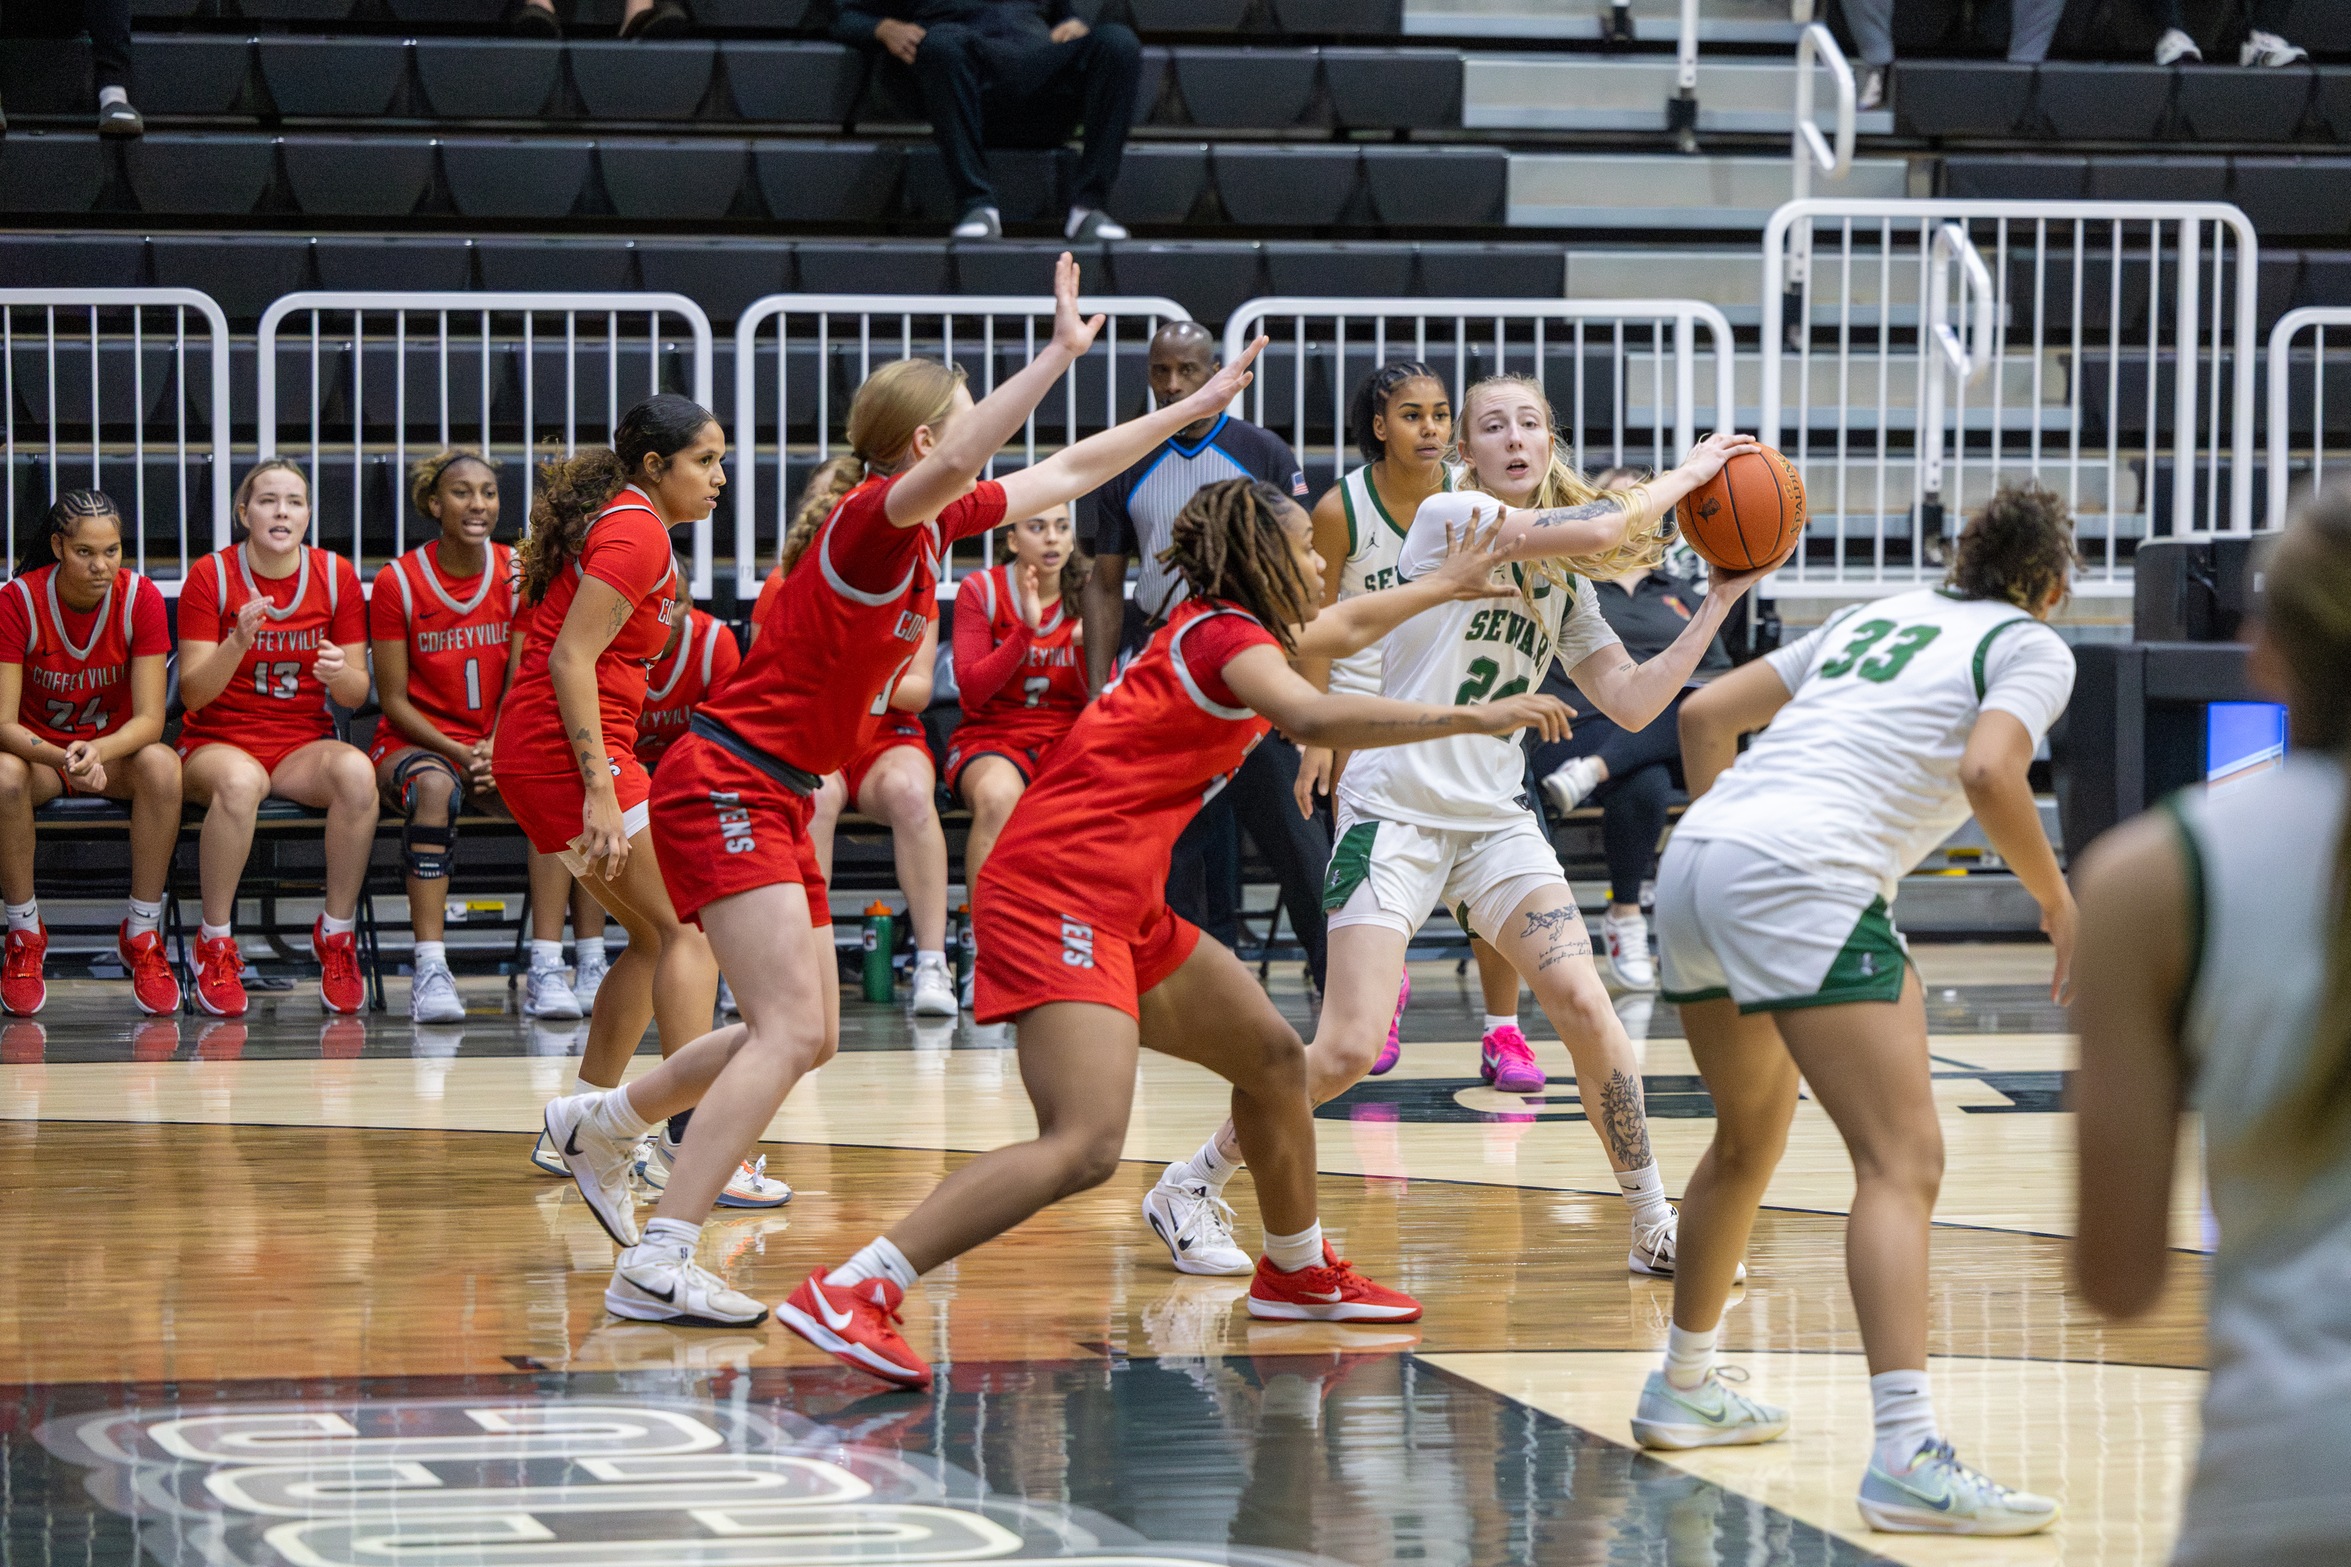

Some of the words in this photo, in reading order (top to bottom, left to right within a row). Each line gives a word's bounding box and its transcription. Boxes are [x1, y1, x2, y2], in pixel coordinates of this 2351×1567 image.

[417, 621, 511, 653] COFFEYVILLE
[1819, 618, 1943, 684] 33
[254, 660, 302, 700] 13
[464, 657, 482, 711] 1
[46, 694, 109, 732] 24
